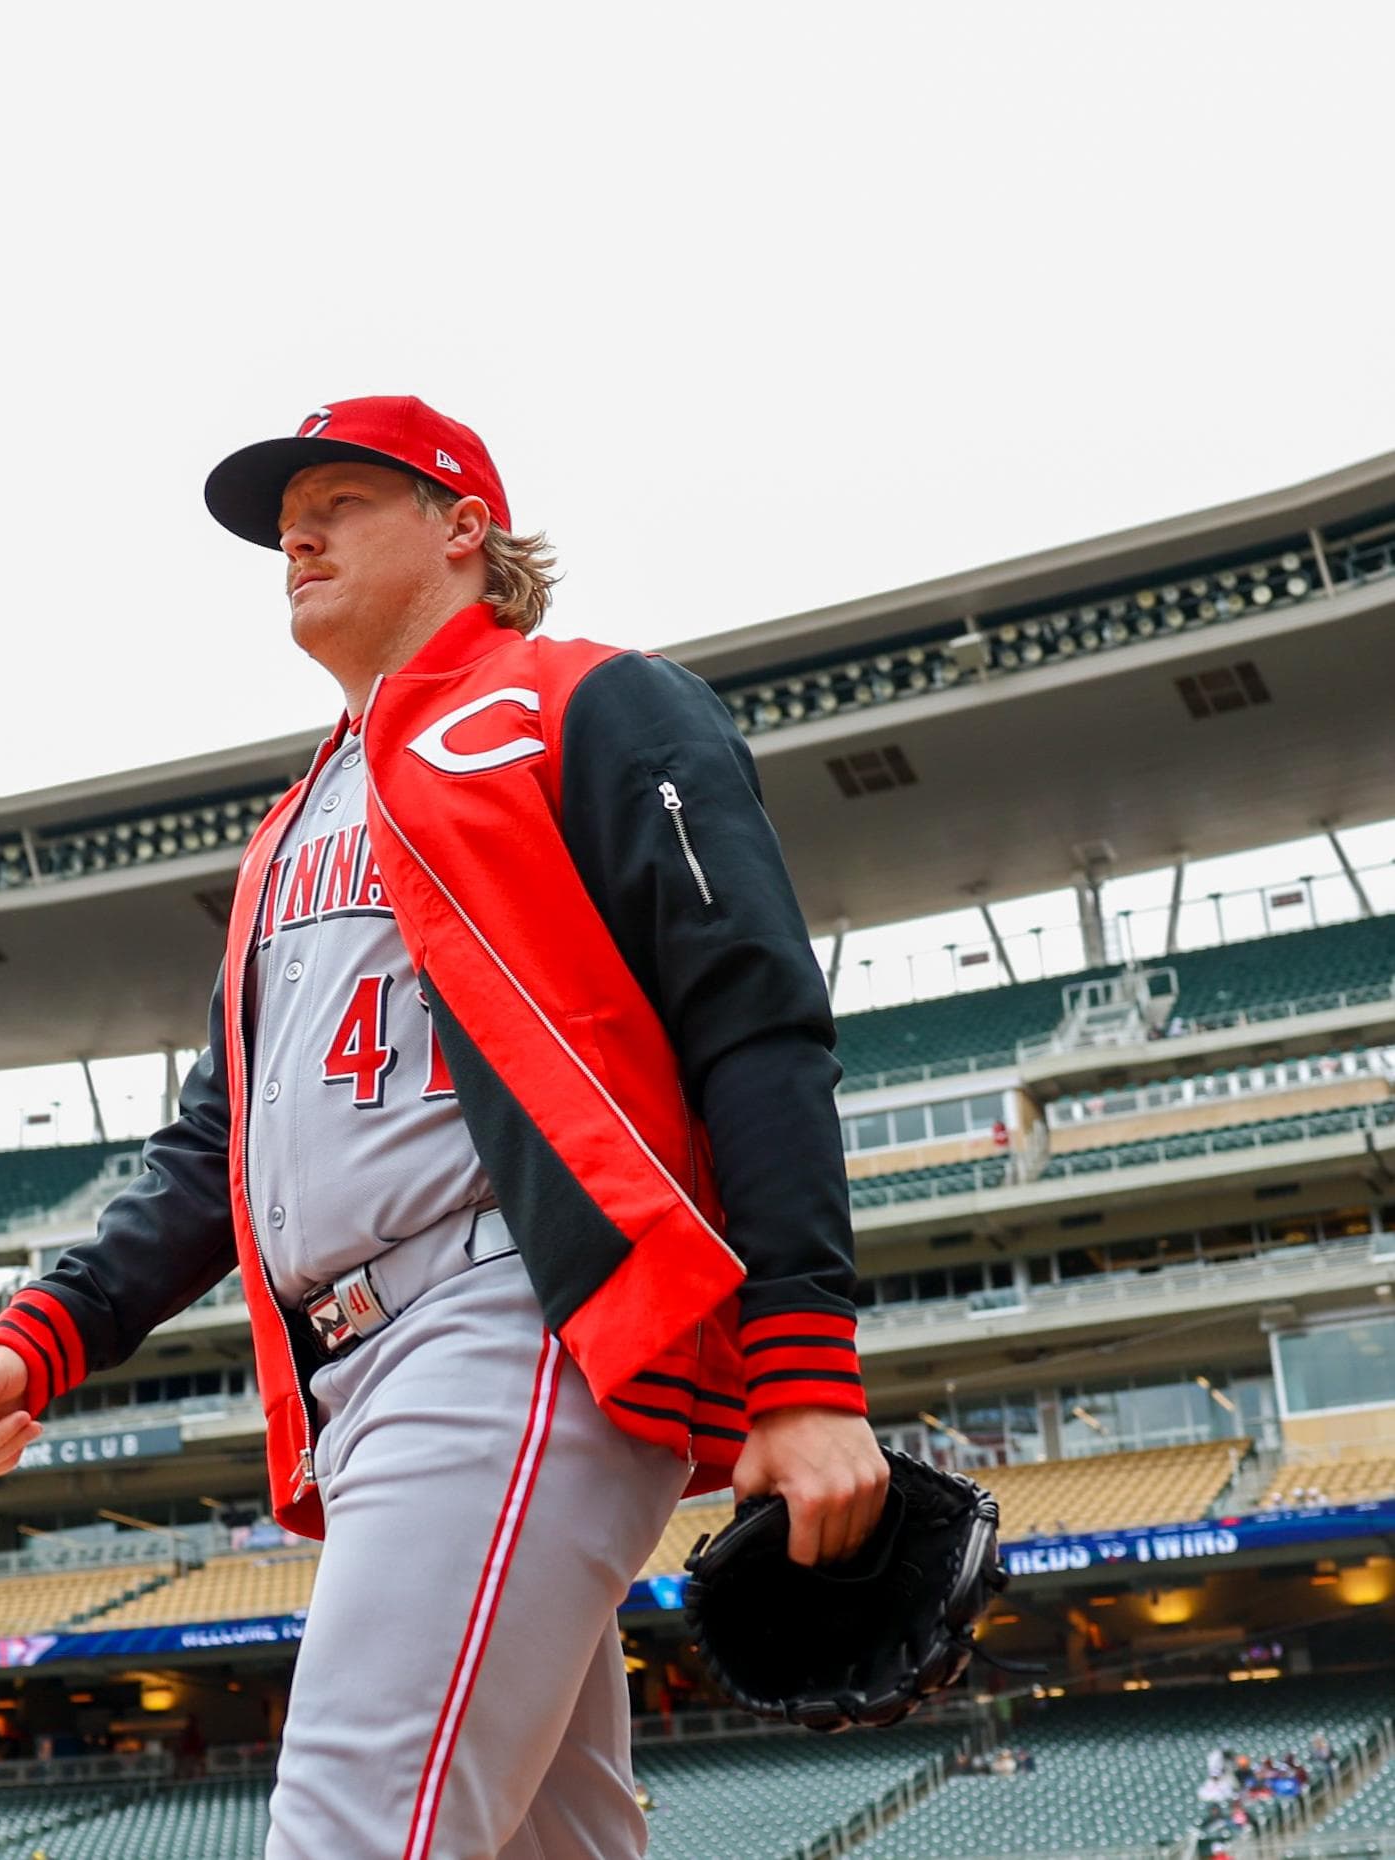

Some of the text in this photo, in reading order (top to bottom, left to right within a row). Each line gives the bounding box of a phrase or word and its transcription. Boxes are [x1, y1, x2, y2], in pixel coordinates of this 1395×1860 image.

[405, 687, 546, 775] C
[348, 1283, 370, 1315] 41
[60, 1434, 139, 1464] CLUB
[1009, 1545, 1090, 1575] REDS
[1136, 1529, 1239, 1562] TWINS
